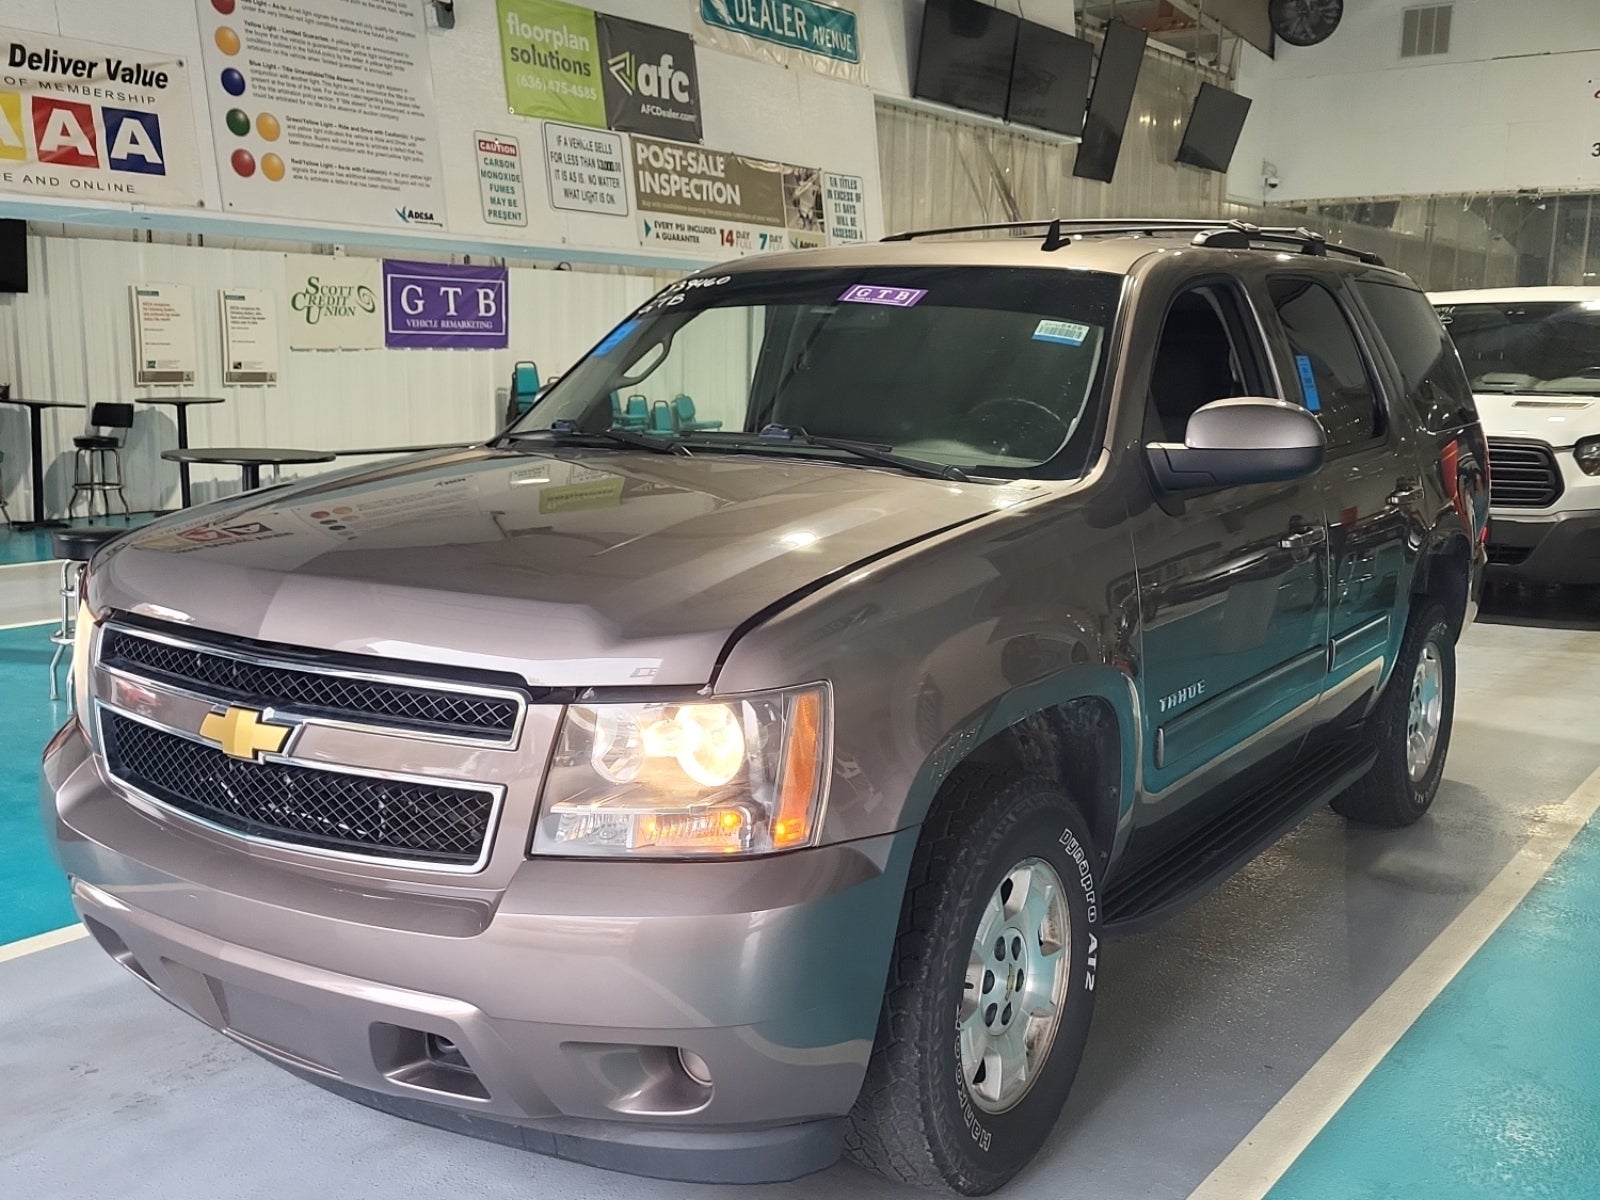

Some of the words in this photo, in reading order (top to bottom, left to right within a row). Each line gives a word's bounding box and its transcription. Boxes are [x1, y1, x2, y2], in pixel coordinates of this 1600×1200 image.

[506, 12, 590, 52] floorplan
[734, 0, 808, 41] DEALER
[812, 26, 854, 53] AVENUE
[8, 43, 98, 79] Deliver
[106, 58, 169, 90] Value
[510, 44, 592, 76] solutions
[516, 74, 546, 92] (636)
[548, 80, 598, 101] 475-4585
[638, 54, 690, 103] afc
[4, 76, 28, 86] OF
[38, 82, 156, 105] MEMBERSHIP
[640, 104, 696, 122] AFCDealer.com
[480, 142, 516, 155] CAUTION
[569, 138, 594, 152] VEHICLE
[595, 142, 612, 154] SELLS
[484, 157, 515, 169] CARBON
[550, 151, 562, 163] FOR
[564, 153, 578, 166] LESS
[580, 156, 595, 168] THAN
[636, 142, 724, 178] POST-SALE
[23, 174, 60, 186] AND
[70, 178, 137, 193] ONLINE
[481, 169, 521, 182] MONOXIDE
[562, 170, 567, 181] IS
[569, 171, 577, 182] AS
[588, 174, 596, 185] NO
[598, 176, 620, 188] MATTER
[489, 184, 515, 194] FUMES
[564, 188, 579, 200] WHAT
[582, 190, 598, 204] LIGHT
[600, 192, 605, 204] IS
[638, 170, 741, 206] INSPECTION
[834, 190, 854, 202] EXCESS
[490, 196, 506, 206] MAY
[508, 199, 518, 207] BE
[408, 210, 434, 221] ADESA
[488, 209, 522, 221] PRESENT
[654, 220, 674, 232] EVERY
[675, 222, 685, 233] PSI
[687, 223, 716, 235] INCLUDES
[662, 233, 700, 244] GUARANTEE
[720, 228, 734, 247] 14
[736, 231, 750, 240] DAY
[759, 234, 768, 250] 7
[769, 234, 783, 243] DAY
[406, 319, 438, 329] VEHICLE
[441, 320, 493, 329] REMARKETING
[1160, 680, 1205, 712] TAHOE
[1059, 828, 1097, 923] Dynapro
[1084, 932, 1098, 992] AT2
